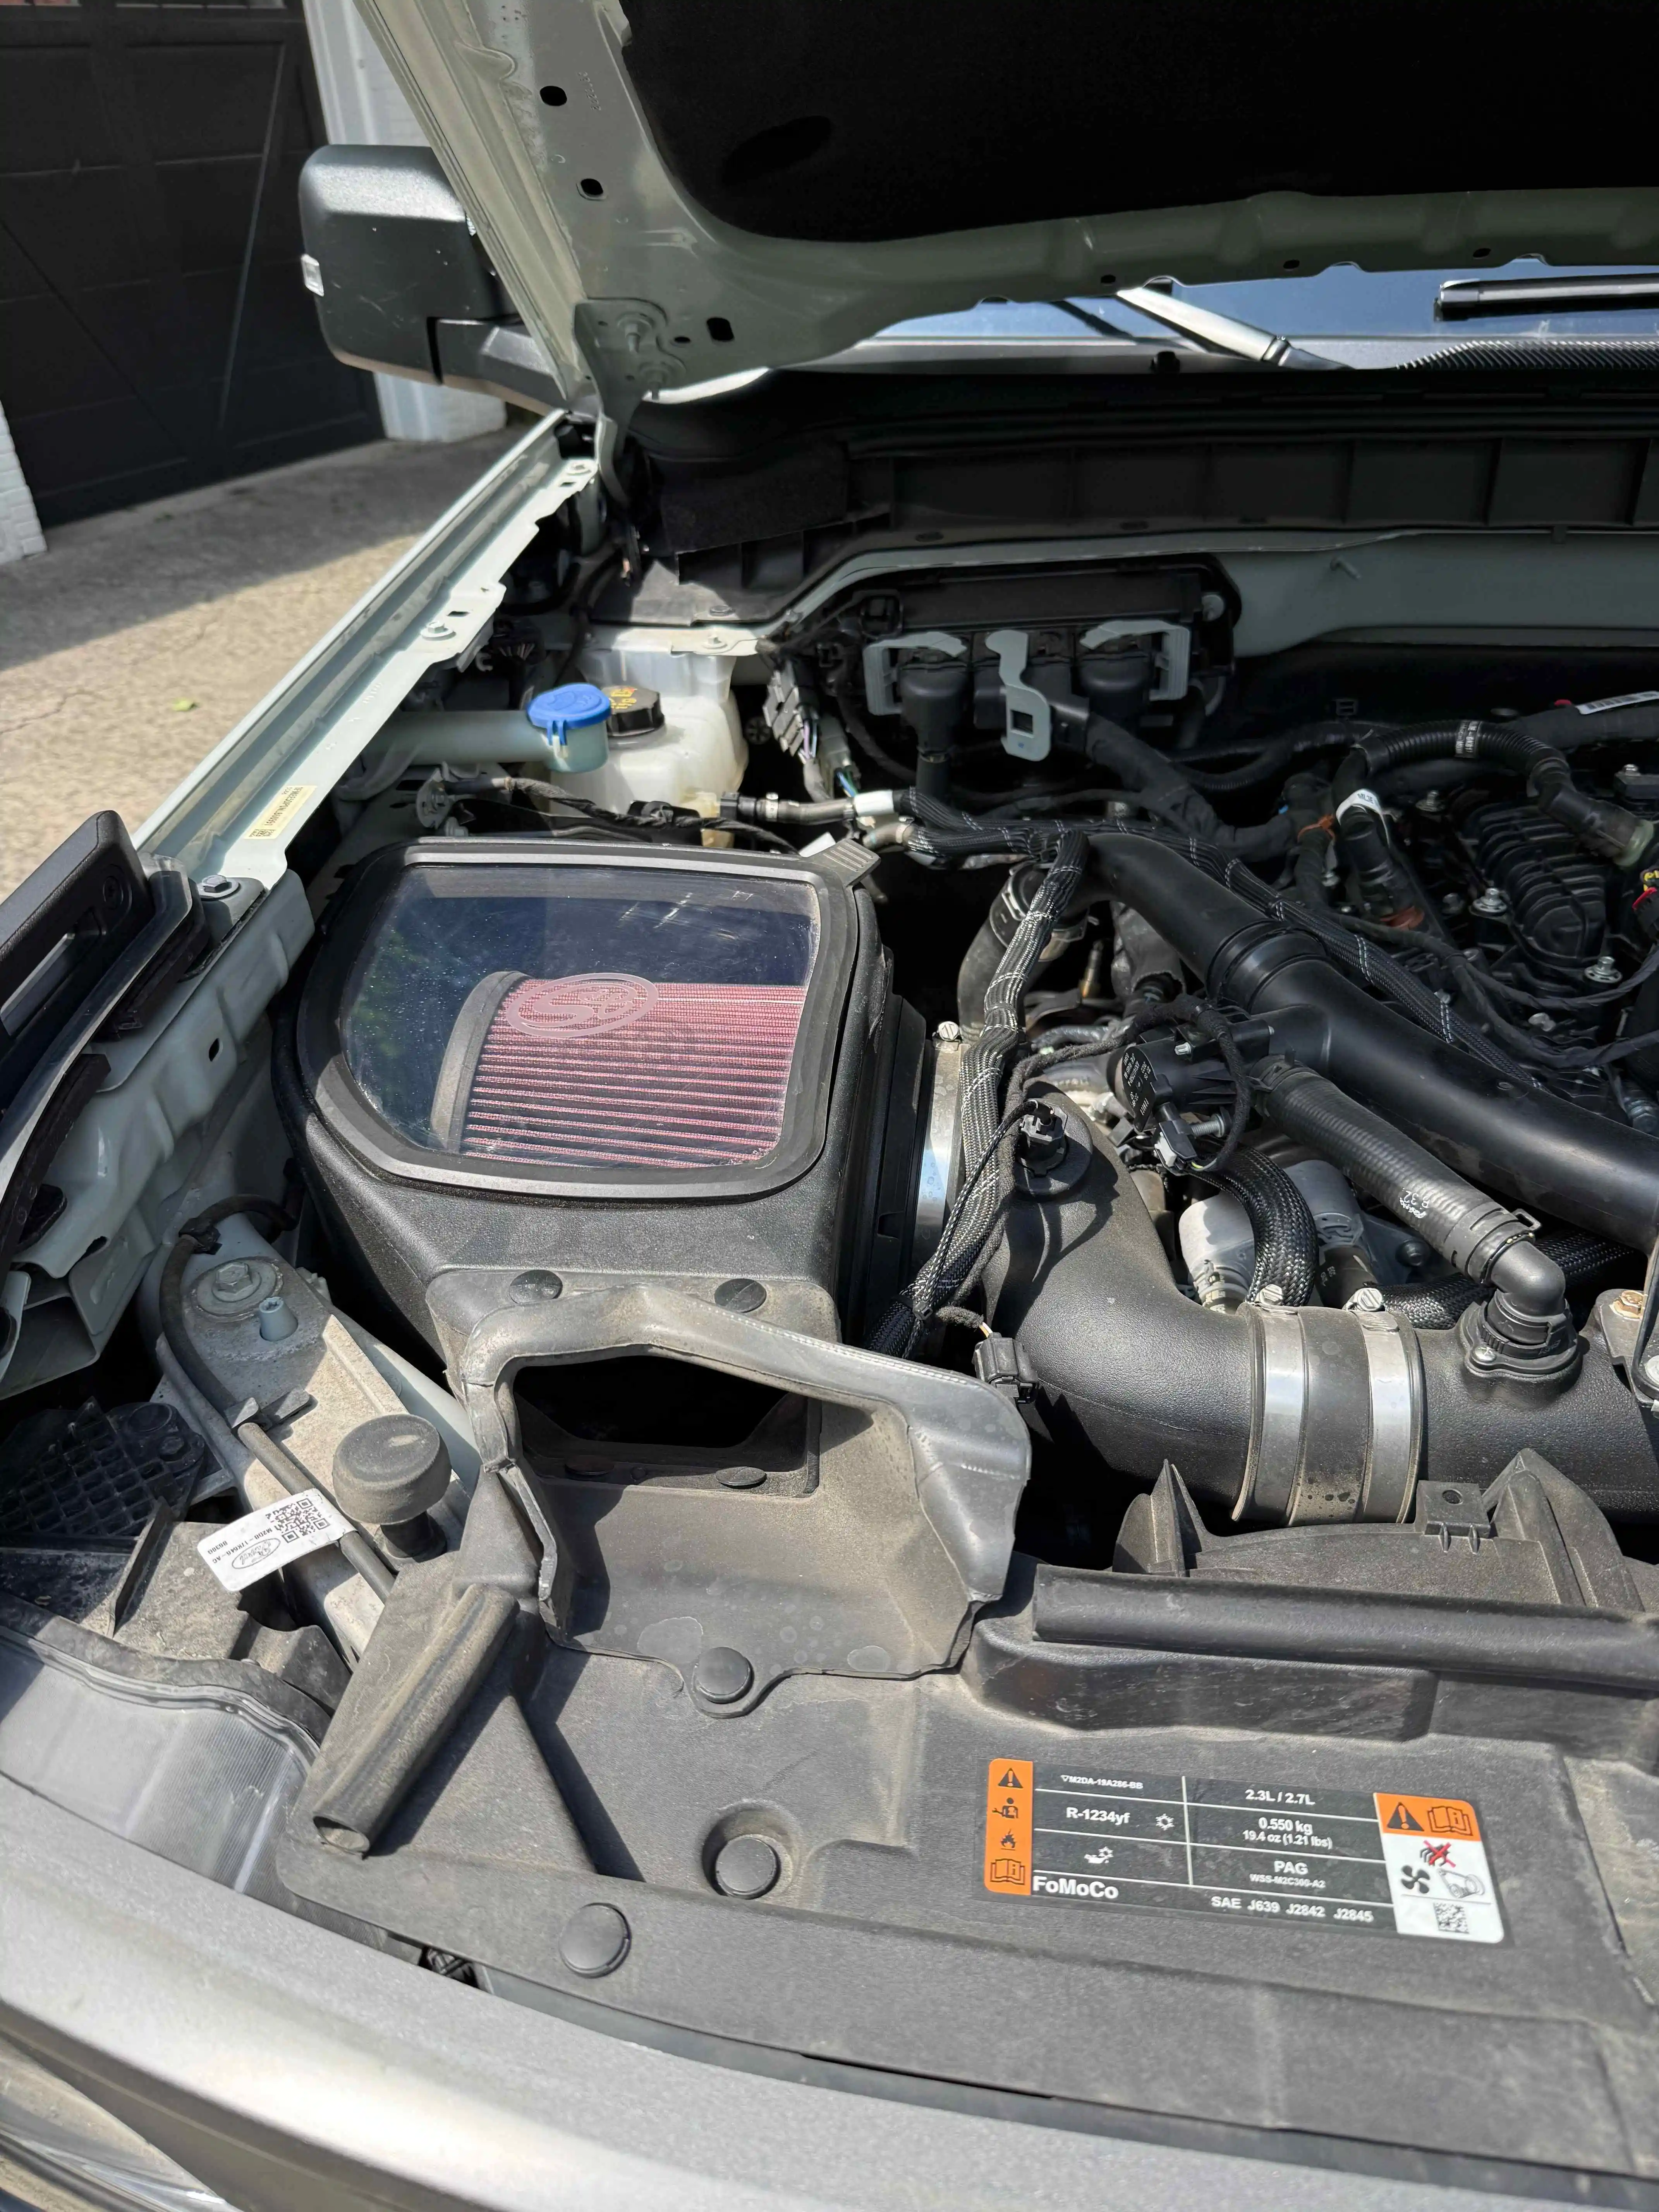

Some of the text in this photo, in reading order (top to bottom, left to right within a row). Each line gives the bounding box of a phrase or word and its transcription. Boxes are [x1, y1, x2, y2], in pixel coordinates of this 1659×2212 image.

[1245, 1789, 1316, 1805] 2.3L / 2.7L
[1066, 1807, 1130, 1824] R-1234yf
[1258, 1817, 1313, 1836] 0.550 kg
[1242, 1829, 1333, 1850] 19.4 oz (1.21 lbs)
[1274, 1860, 1309, 1875] PAG
[1032, 1875, 1119, 1899] FoMoCo
[1211, 1896, 1375, 1923] SAE J639 J2842 J2845
